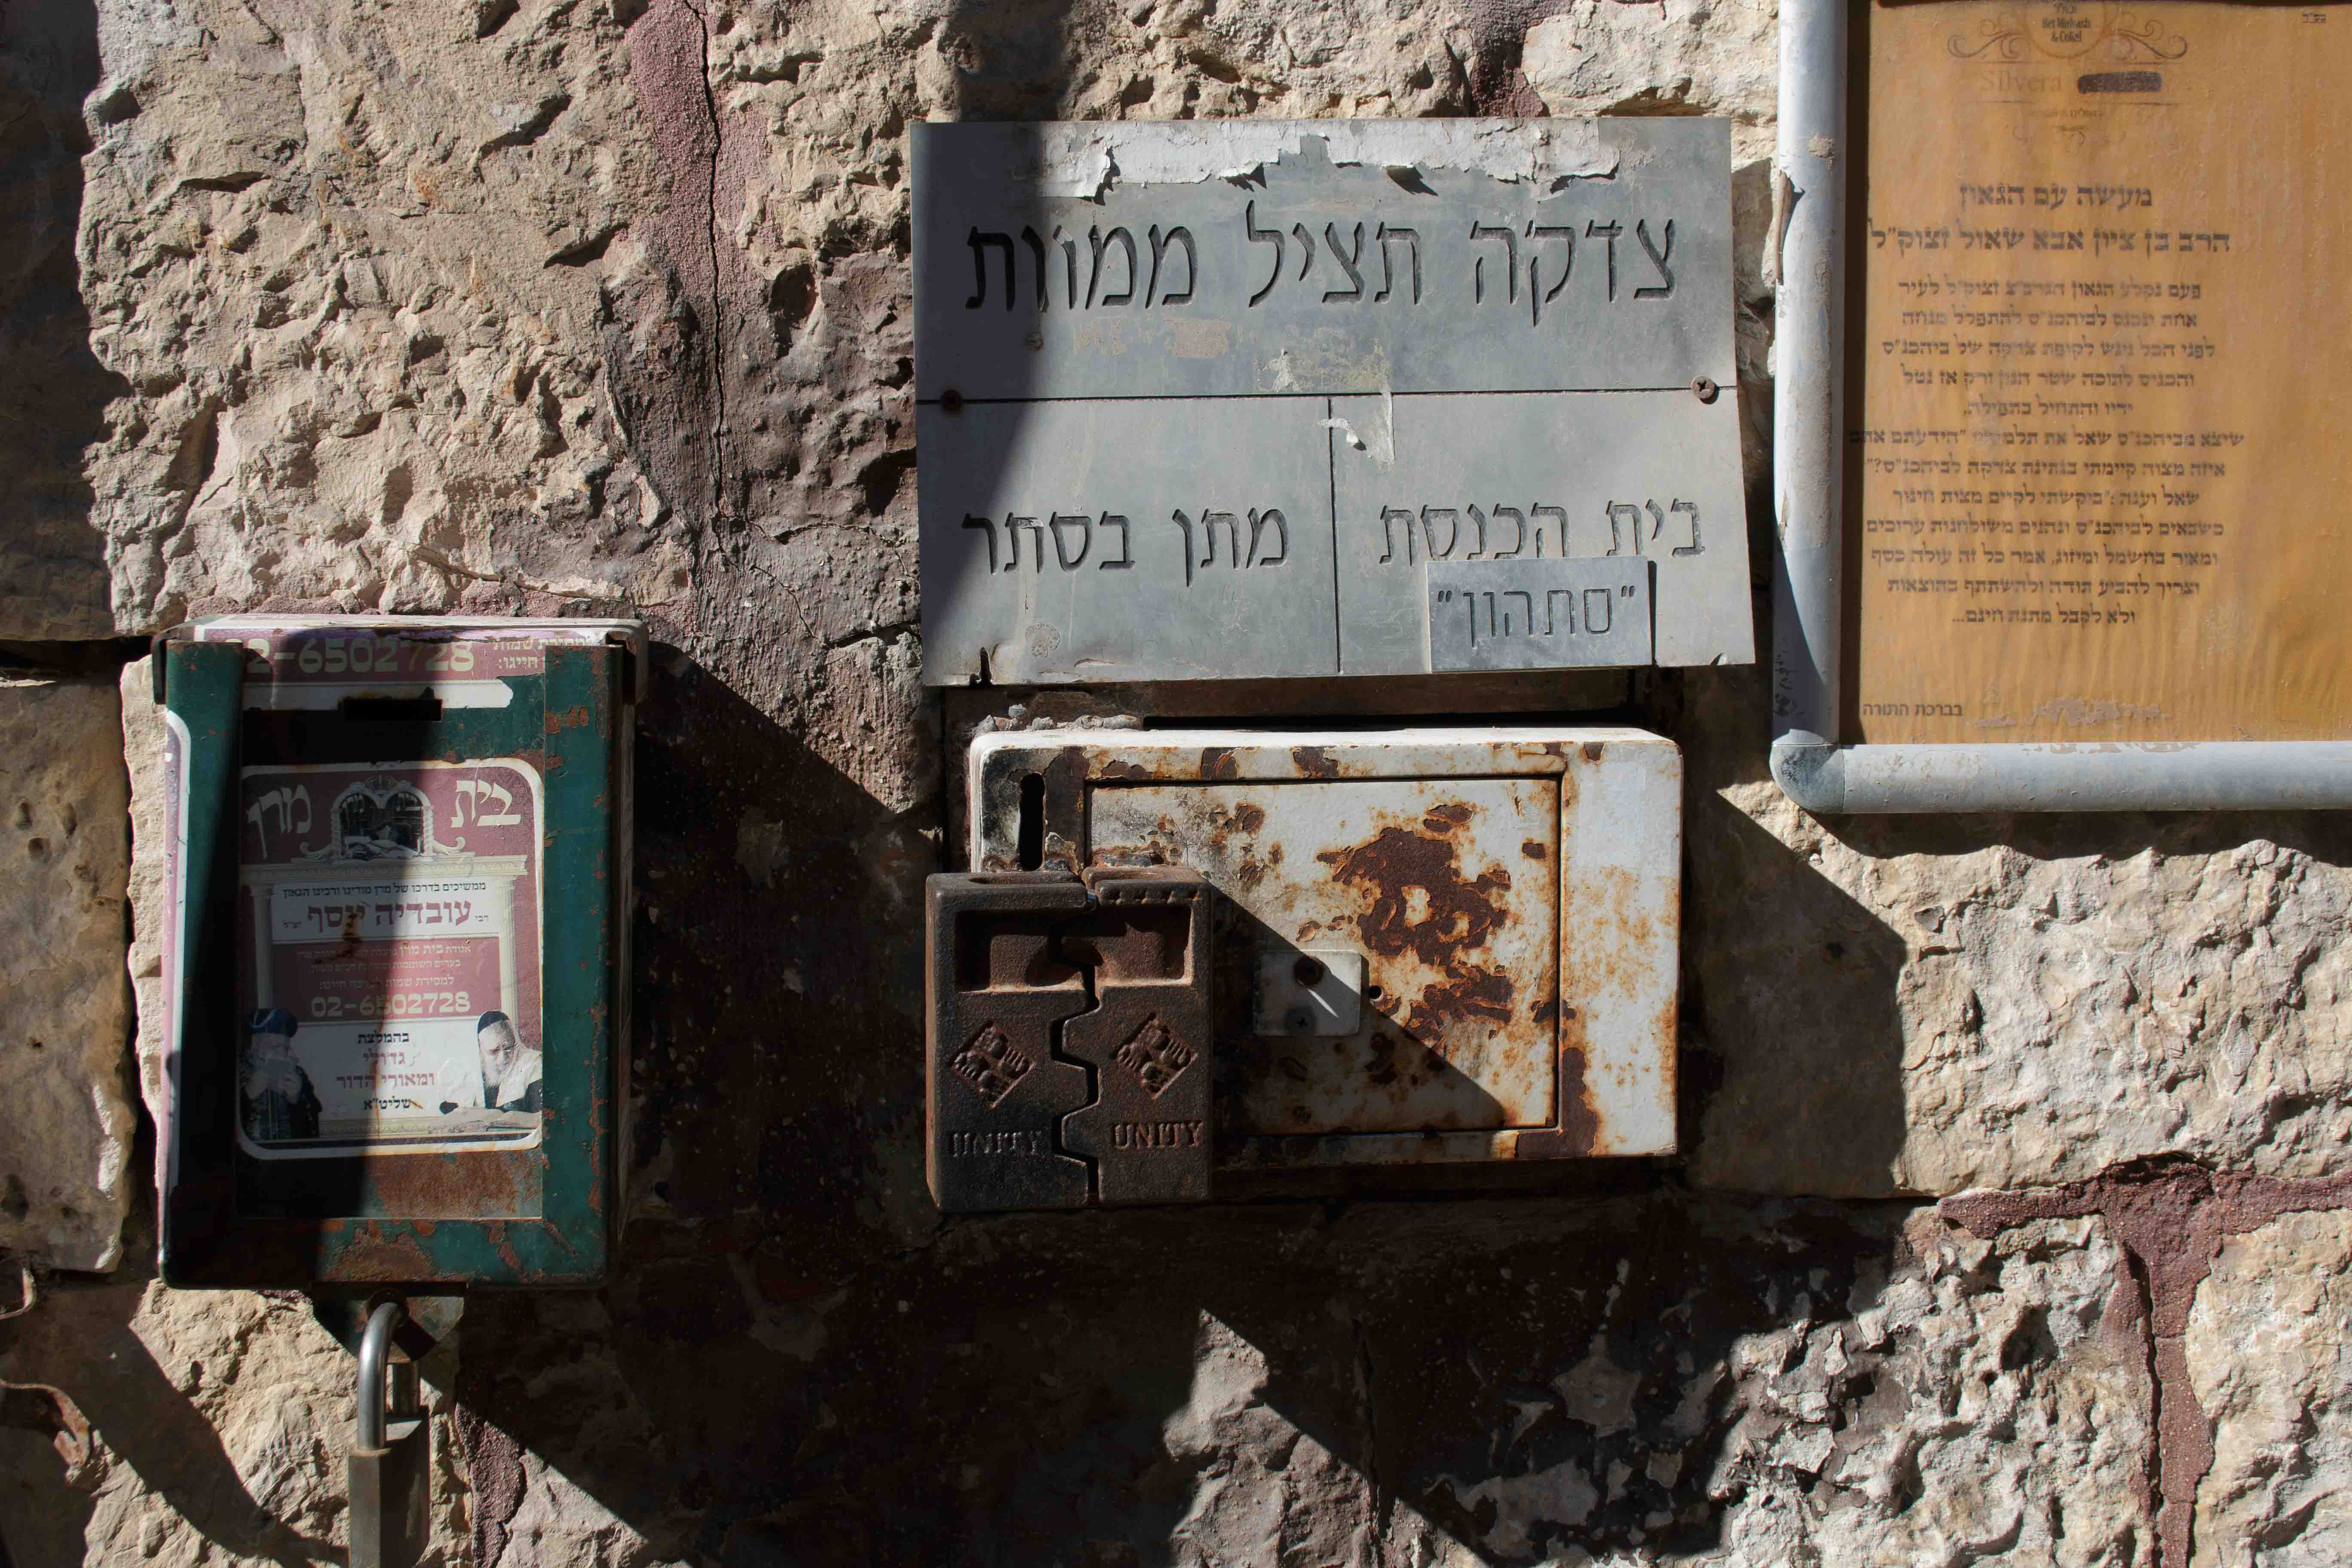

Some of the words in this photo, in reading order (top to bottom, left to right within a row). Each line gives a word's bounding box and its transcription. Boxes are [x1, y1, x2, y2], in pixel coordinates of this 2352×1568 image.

[1960, 183, 2025, 211] הגאון
[2034, 183, 2067, 210] עם
[2077, 184, 2152, 211] מעשה
[1955, 217, 2024, 249] שאול
[2034, 228, 2084, 251] אבא
[2093, 229, 2135, 257] ציון
[2145, 228, 2169, 258] בן
[2179, 230, 2230, 252] הרב
[1246, 200, 1421, 309] תציל
[965, 224, 1197, 310] ממוות
[1469, 217, 1675, 326] צדקה
[1899, 273, 1940, 297] לעיר
[2072, 280, 2114, 300] הגאון
[2167, 282, 2201, 300] פעם
[2161, 312, 2197, 327] אחת
[1954, 334, 1983, 355] של
[2138, 335, 2177, 357] הכל
[2180, 335, 2215, 358] לפני
[1901, 363, 1933, 384] נטל
[2036, 392, 2098, 415] והתחיל
[2044, 431, 2067, 445] את
[2073, 424, 2111, 445] שאל
[1968, 459, 2017, 480] צדקה
[2190, 460, 2225, 477] איזה
[2161, 484, 2200, 506] שאל
[1380, 502, 1569, 566] הכנסת
[1607, 499, 1705, 559] בית
[962, 511, 1135, 575] בסתר
[1173, 507, 1287, 587] מתן
[1980, 542, 2005, 564] כל
[2103, 543, 2166, 565] בחשמל
[1958, 549, 1977, 564] זה
[2011, 550, 2047, 564] אמר
[1437, 585, 1635, 648] "סתהון"
[2056, 602, 2102, 627] לקבל
[2106, 602, 2136, 625] ולא
[226, 638, 474, 674] 2-6502728
[1863, 704, 1909, 716] התורה
[1915, 704, 1963, 716] בברכת
[450, 779, 522, 828] בית
[245, 784, 312, 861] מרן
[375, 886, 391, 896] מרן
[393, 882, 409, 893] של
[411, 882, 440, 892] בדרכו
[444, 882, 486, 891] ממשיכים
[308, 903, 365, 934] יוסף
[376, 900, 471, 926] עובדיה
[416, 974, 454, 986] למסירת
[311, 991, 471, 1018] 02-6502728
[358, 1030, 409, 1044] בהמלצת
[382, 1073, 434, 1088] ומאורי
[364, 1096, 410, 1110] שליט"א
[1112, 1122, 1204, 1148] UNITY
